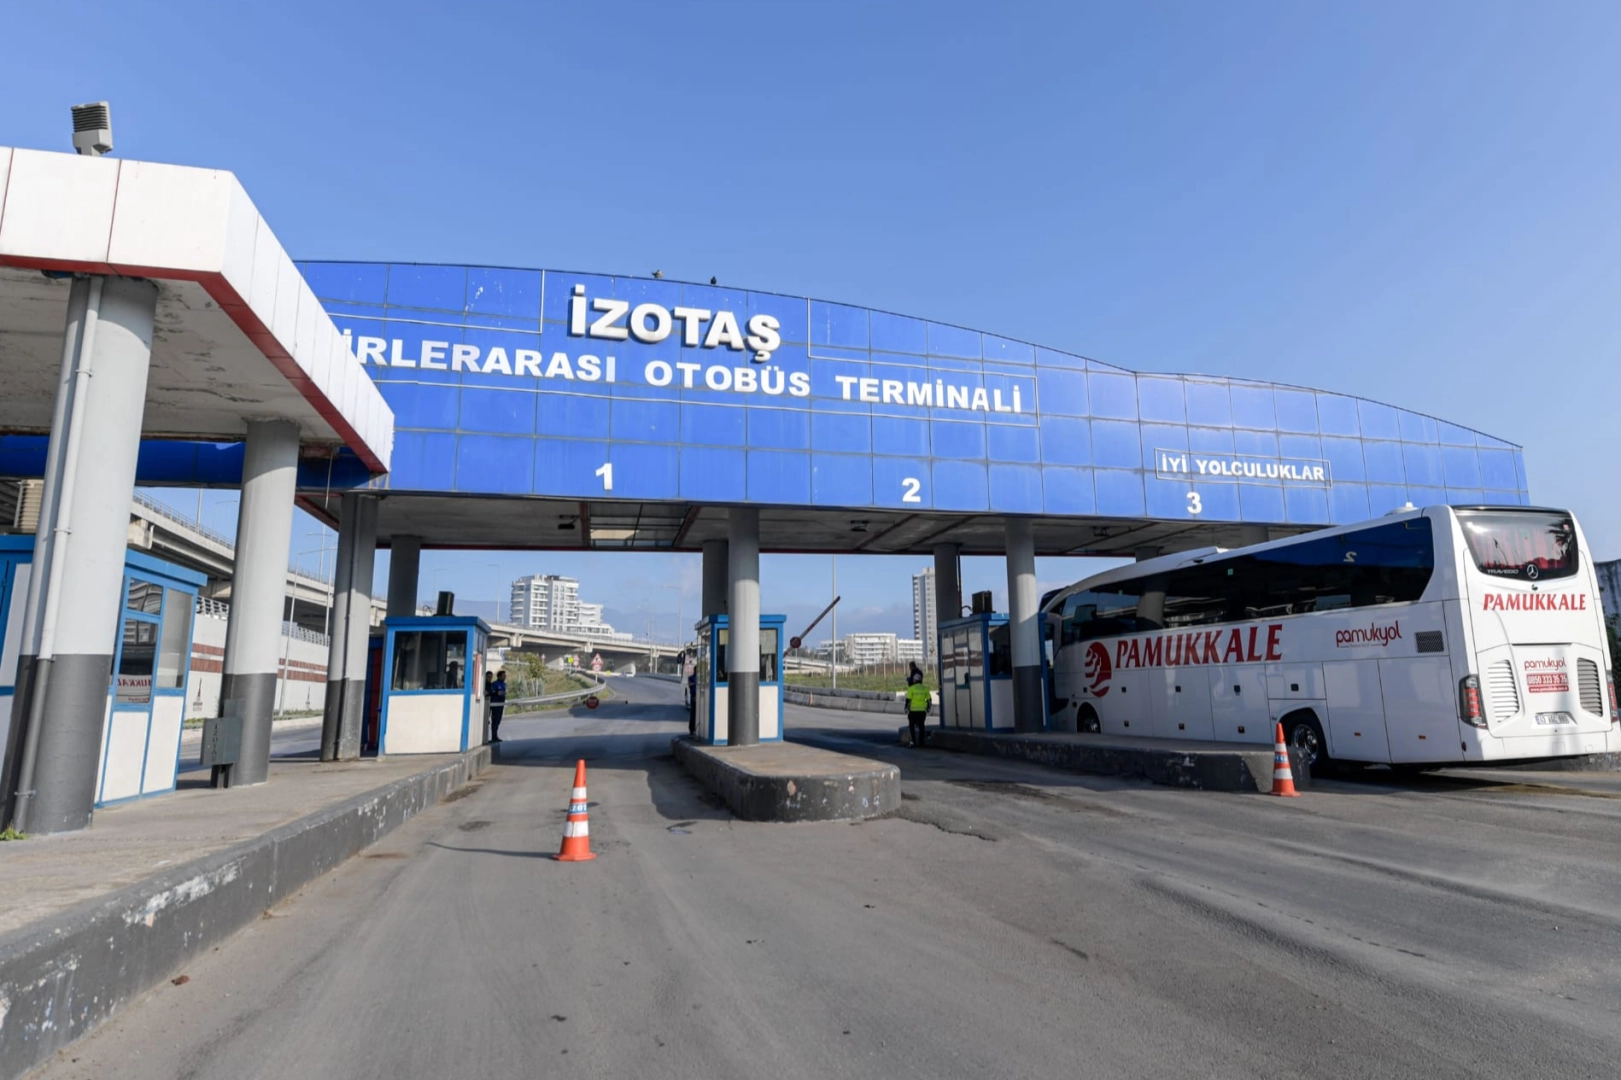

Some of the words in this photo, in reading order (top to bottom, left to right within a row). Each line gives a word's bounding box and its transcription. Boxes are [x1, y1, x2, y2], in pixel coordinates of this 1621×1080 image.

[569, 284, 781, 362] İZOTAŞ
[644, 360, 811, 397] OTOBÜS
[835, 375, 1022, 413] TERMİNALİ
[595, 463, 613, 490] 1
[1162, 453, 1188, 473] İYİ
[1195, 459, 1325, 481] YOLCULUKLAR
[902, 478, 921, 502] 2
[1186, 491, 1203, 514] 3
[1483, 593, 1586, 611] PAMUKKALE
[1115, 624, 1283, 669] PAMUKKALE
[1336, 620, 1402, 648] pamukyol
[1524, 657, 1566, 671] pamukyol
